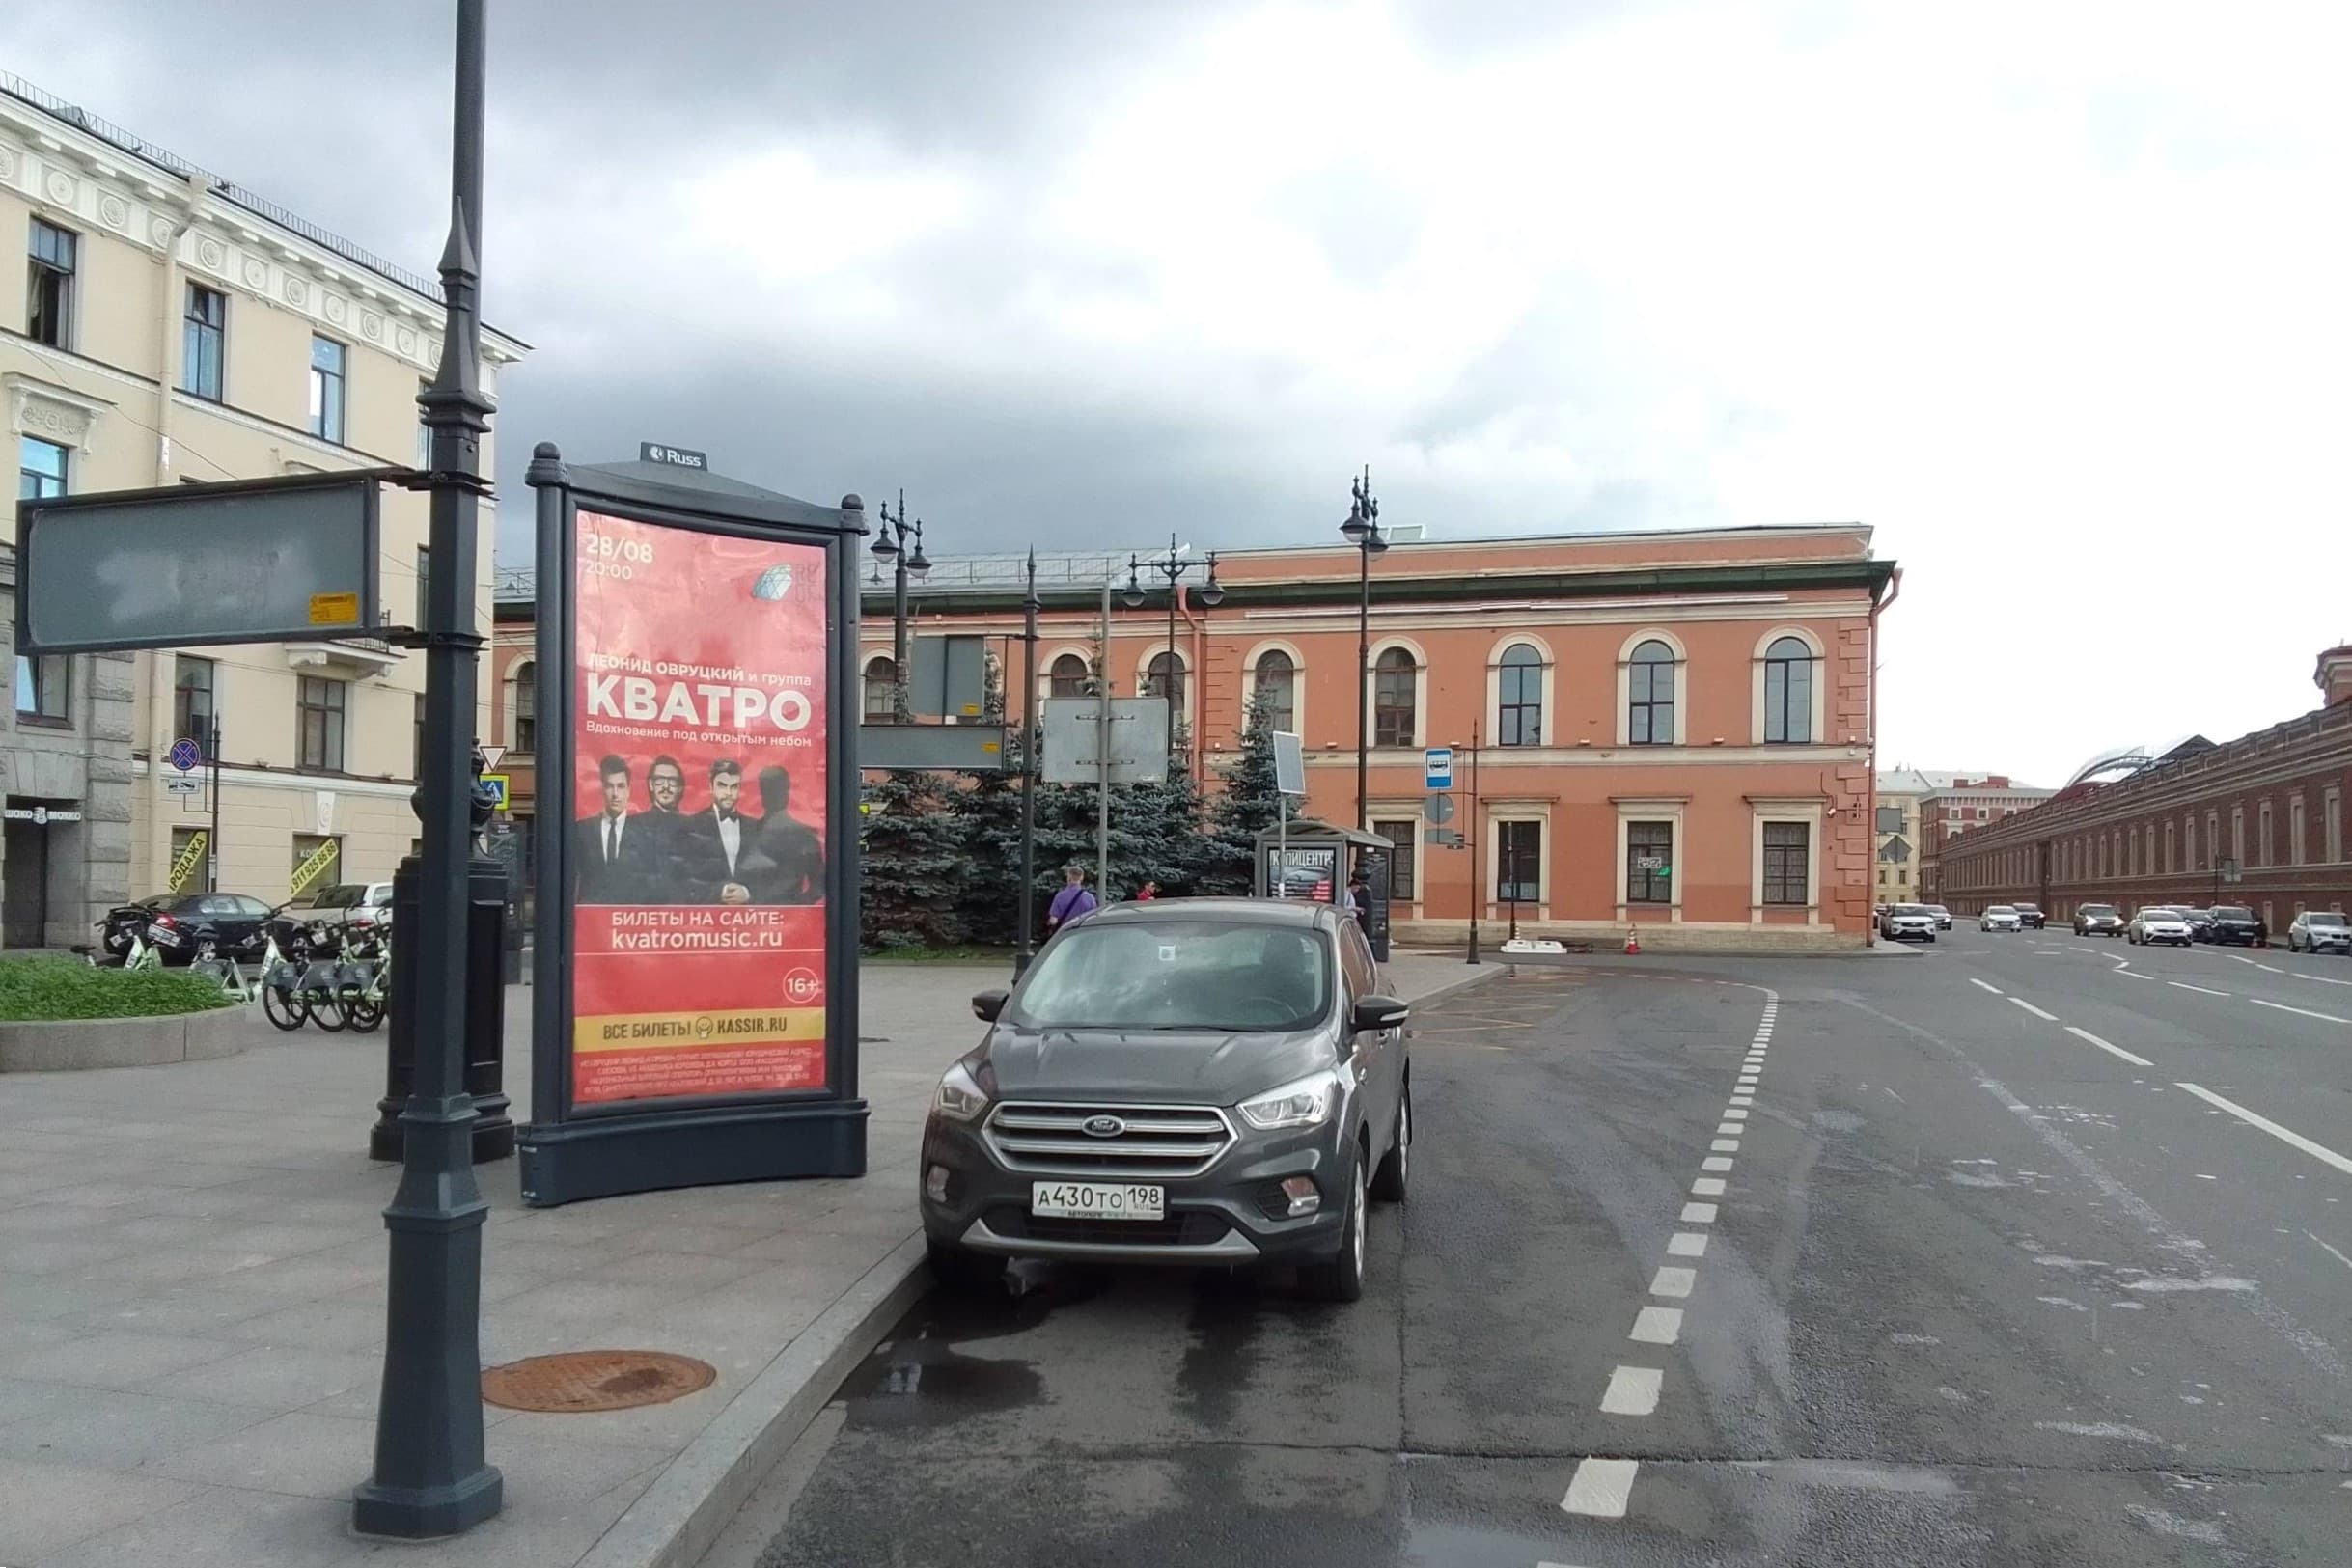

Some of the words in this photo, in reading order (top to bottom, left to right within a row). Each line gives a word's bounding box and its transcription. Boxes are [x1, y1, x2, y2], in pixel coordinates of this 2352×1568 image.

[667, 450, 702, 467] Russ
[587, 534, 653, 564] 28/08
[586, 560, 633, 581] 20:00
[589, 653, 652, 675] ЛЕОНИД
[656, 660, 744, 683] ОВРУЦКИЙ
[748, 672, 758, 682] и
[761, 673, 812, 687] группа
[587, 672, 812, 731] КВАТРО
[586, 720, 670, 740] Вдохновение
[673, 729, 697, 743] под
[701, 732, 766, 746] открытым
[770, 732, 812, 747] небом
[612, 911, 684, 926] БИЛЕТЫ
[689, 912, 714, 925] НА
[719, 909, 785, 926] САЙТЕ:
[611, 928, 783, 949] kvatromusic.ru
[787, 977, 818, 994] 16+
[602, 1023, 628, 1040] ВСЕ
[631, 1021, 692, 1039] БИЛЕТЫ
[716, 1016, 788, 1034] KASSIR.RU
[1126, 1187, 1160, 1205] 198
